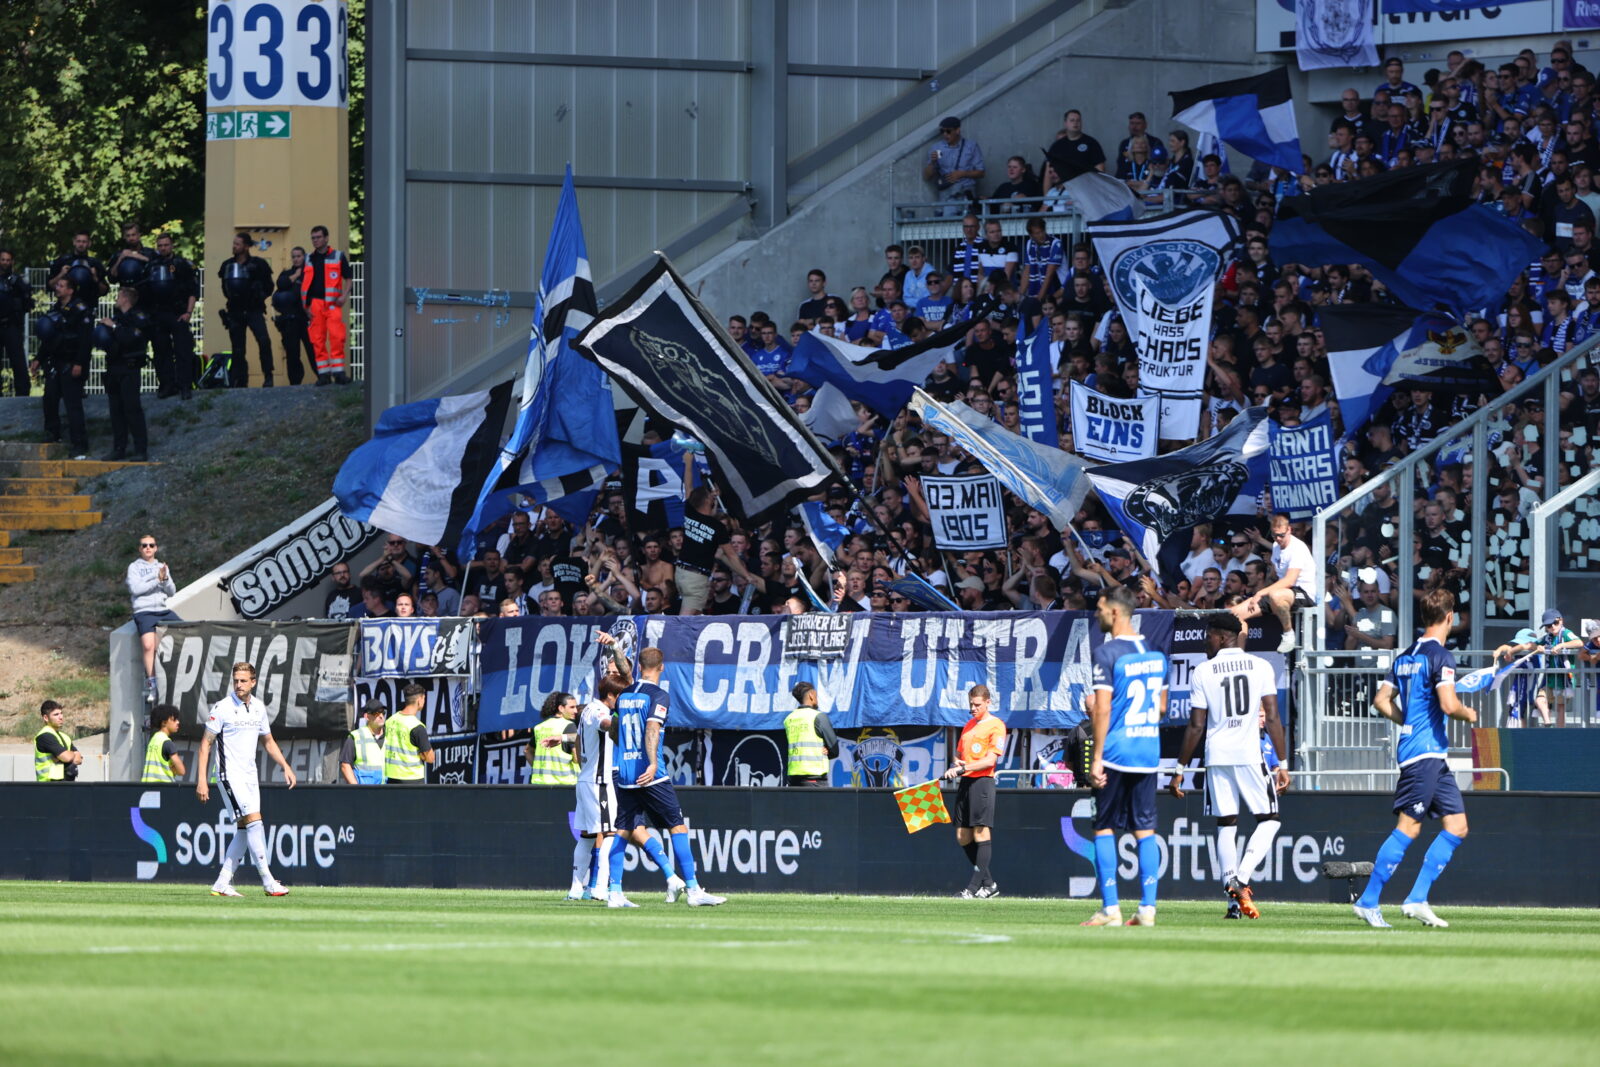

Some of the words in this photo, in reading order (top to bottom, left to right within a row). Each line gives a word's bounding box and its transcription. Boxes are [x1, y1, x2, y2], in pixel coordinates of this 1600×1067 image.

[243, 3, 284, 100] 3
[296, 4, 332, 101] 3
[1141, 289, 1205, 324] LIEBE
[1138, 331, 1201, 363] CHAOS
[1153, 324, 1185, 338] HASS
[1138, 358, 1194, 378] STRUKTUR
[1086, 395, 1144, 421] BLOCK
[1086, 415, 1145, 449] EINS
[1270, 453, 1334, 482] ULTRAS
[1272, 480, 1337, 508] ARMINIA
[941, 514, 989, 541] 1905
[231, 506, 378, 616] SAMSO
[830, 615, 848, 630] ALS
[1174, 629, 1203, 641] BLOCK
[1247, 627, 1263, 639] 998
[363, 624, 437, 672] BOYS
[500, 620, 670, 715] LOKL
[692, 618, 872, 714] CREW
[899, 613, 1142, 712] ULTRA
[155, 634, 318, 728] SPENGE
[1212, 659, 1254, 674] BIELEFELD
[1124, 676, 1163, 726] 23
[1220, 674, 1250, 718] 10
[622, 712, 642, 750] 11
[337, 825, 355, 843] AG
[801, 830, 822, 849] AG
[1117, 816, 1321, 883] sftre
[1322, 836, 1345, 856] AG
